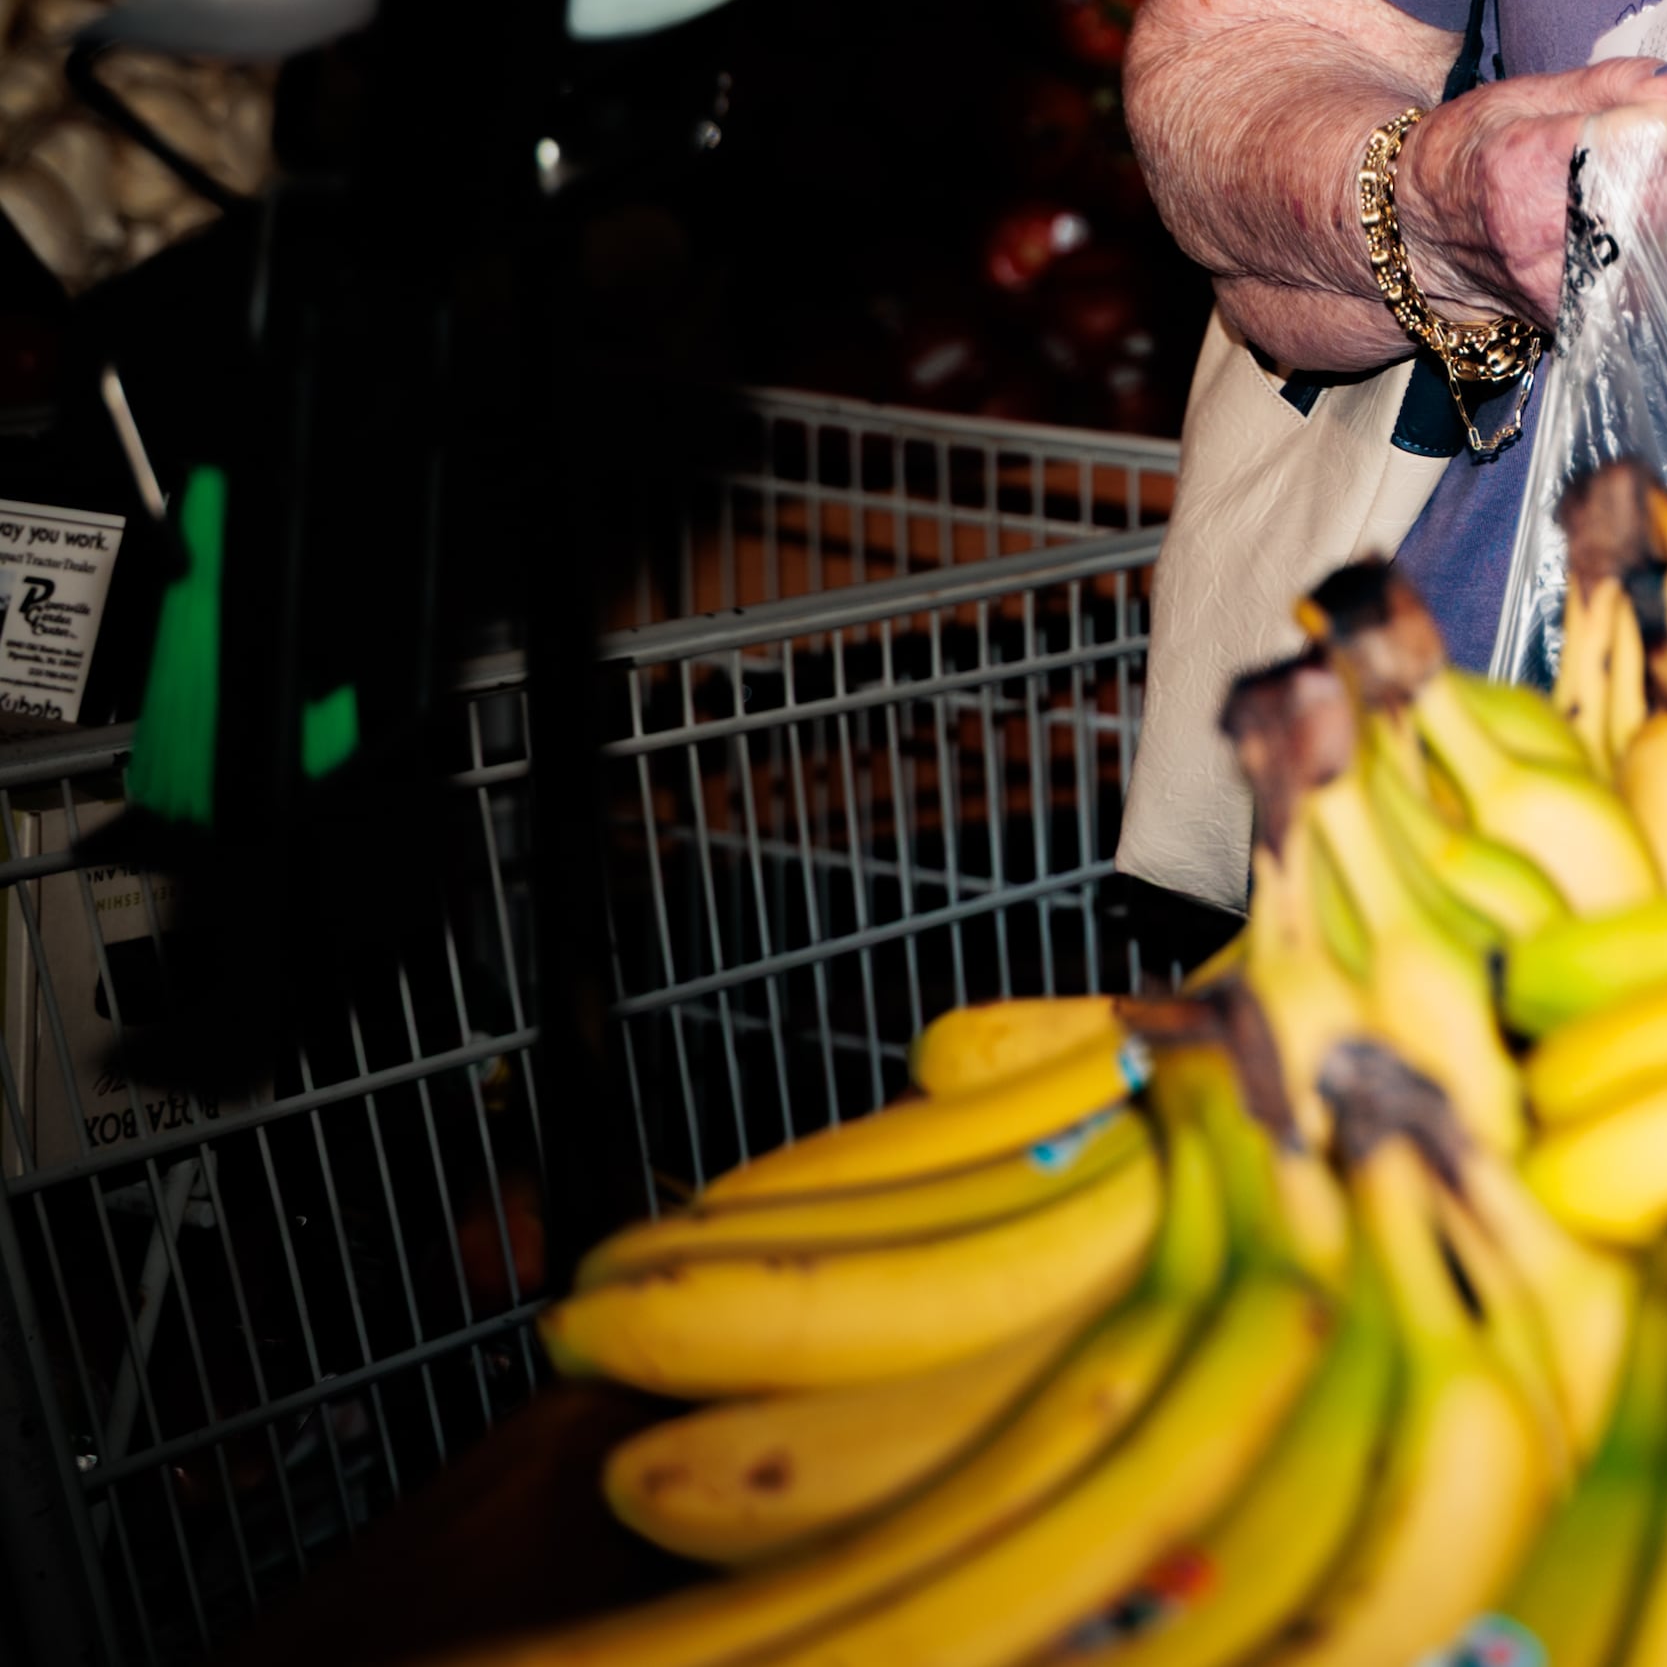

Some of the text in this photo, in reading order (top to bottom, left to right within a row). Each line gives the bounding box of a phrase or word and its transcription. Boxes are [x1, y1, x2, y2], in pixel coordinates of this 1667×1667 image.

[27, 525, 60, 545] you
[64, 530, 109, 551] work.
[25, 552, 62, 569] Tractor
[63, 558, 97, 574] Dealer
[84, 1112, 140, 1148] BOX
